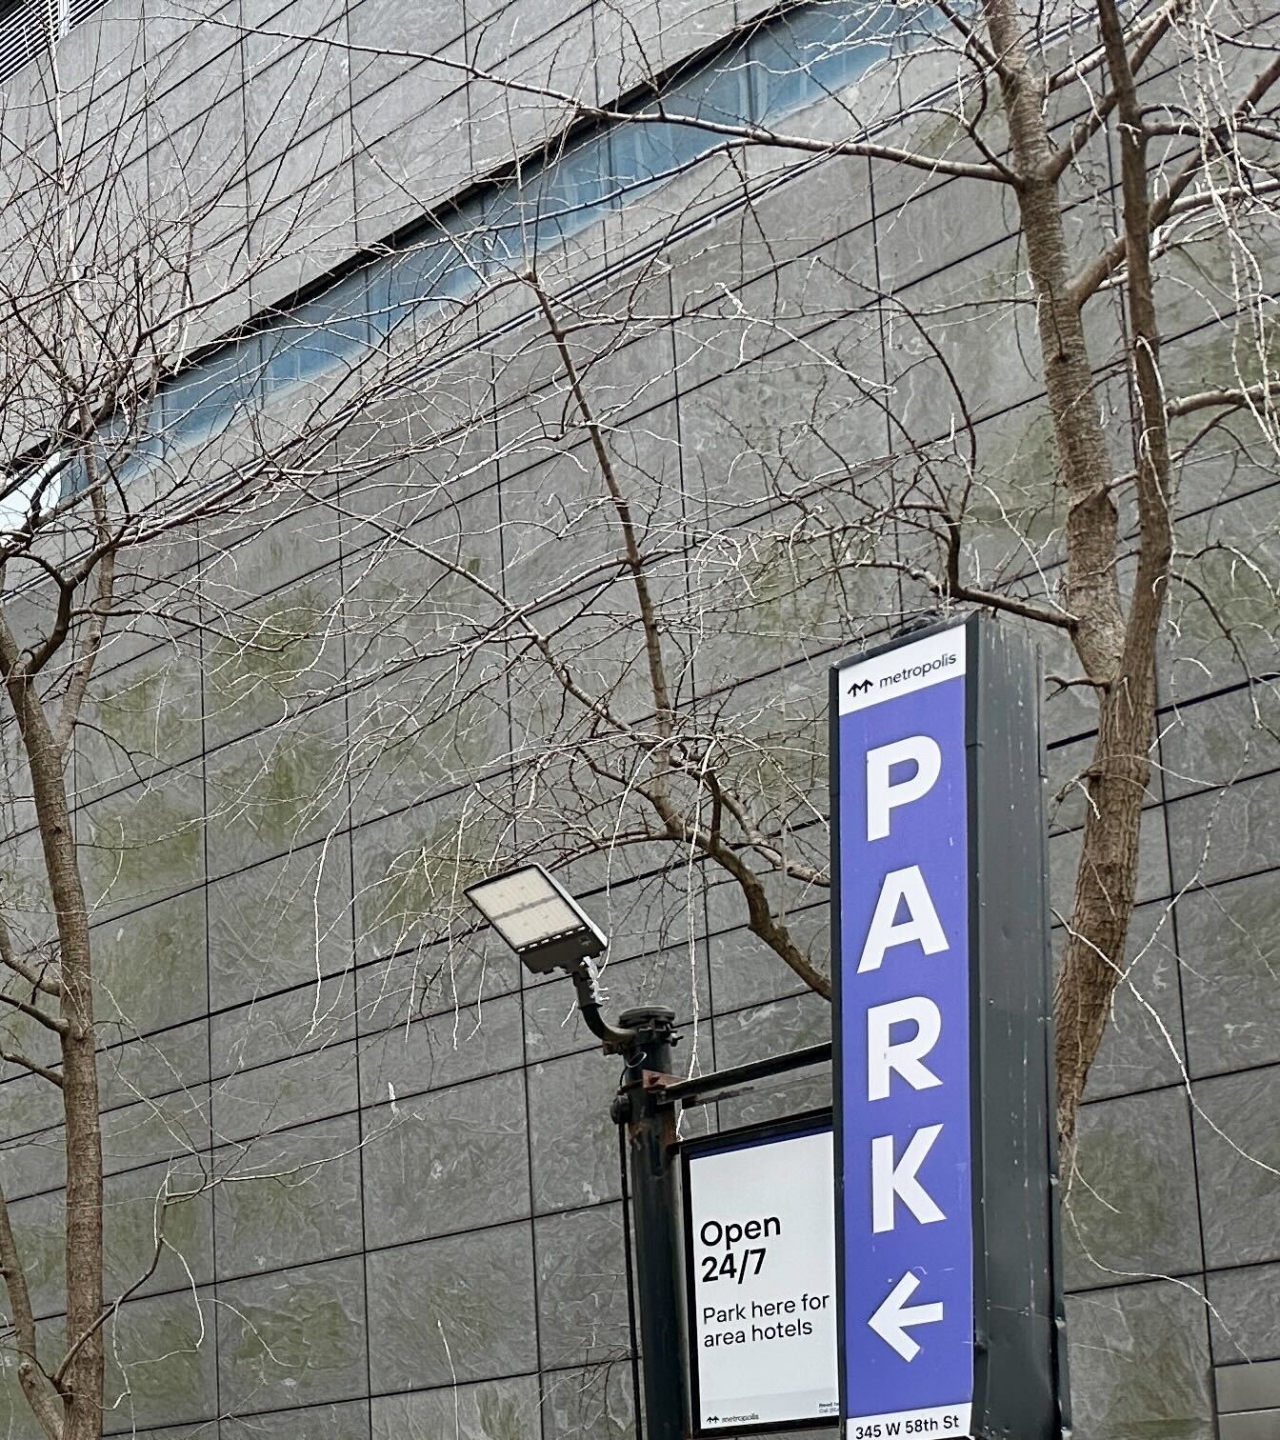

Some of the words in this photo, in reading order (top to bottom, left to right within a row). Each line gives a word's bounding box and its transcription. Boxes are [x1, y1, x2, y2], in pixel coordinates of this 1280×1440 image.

[879, 653, 957, 689] metropolis
[856, 734, 950, 1234] PARK
[700, 1216, 781, 1250] Open
[701, 1248, 766, 1285] 24/7
[703, 1303, 746, 1325] Park
[751, 1300, 796, 1318] here
[801, 1293, 830, 1311] for
[704, 1329, 746, 1348] area
[752, 1318, 813, 1342] hotels
[722, 1412, 759, 1424] metropolis
[855, 1425, 882, 1440] 345
[886, 1422, 901, 1436] W
[905, 1418, 938, 1433] 58th
[943, 1415, 959, 1429] St
